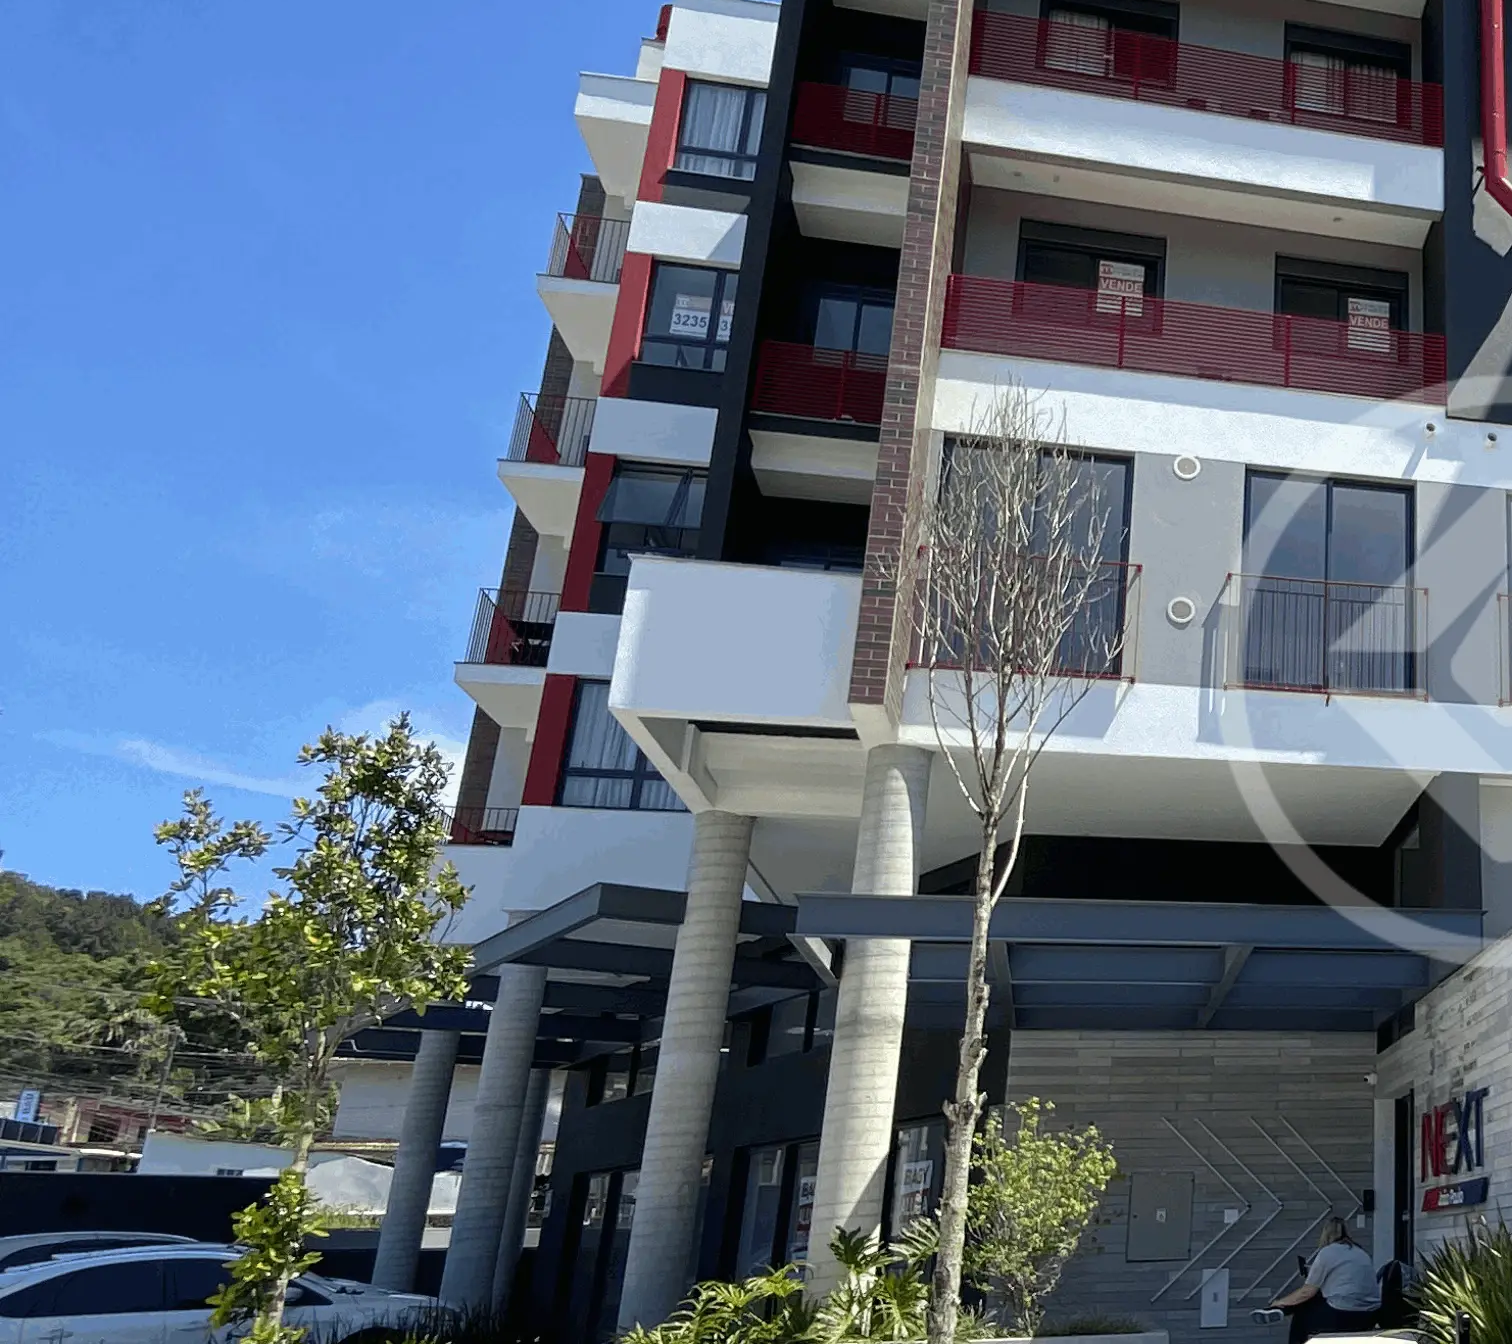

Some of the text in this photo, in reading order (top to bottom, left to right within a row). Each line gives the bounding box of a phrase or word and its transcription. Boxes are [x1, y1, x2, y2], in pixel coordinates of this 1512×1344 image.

[1100, 277, 1142, 293] VENDE
[673, 313, 708, 328] 3235
[1348, 314, 1389, 329] VENDE
[1420, 1086, 1492, 1183] NEXT
